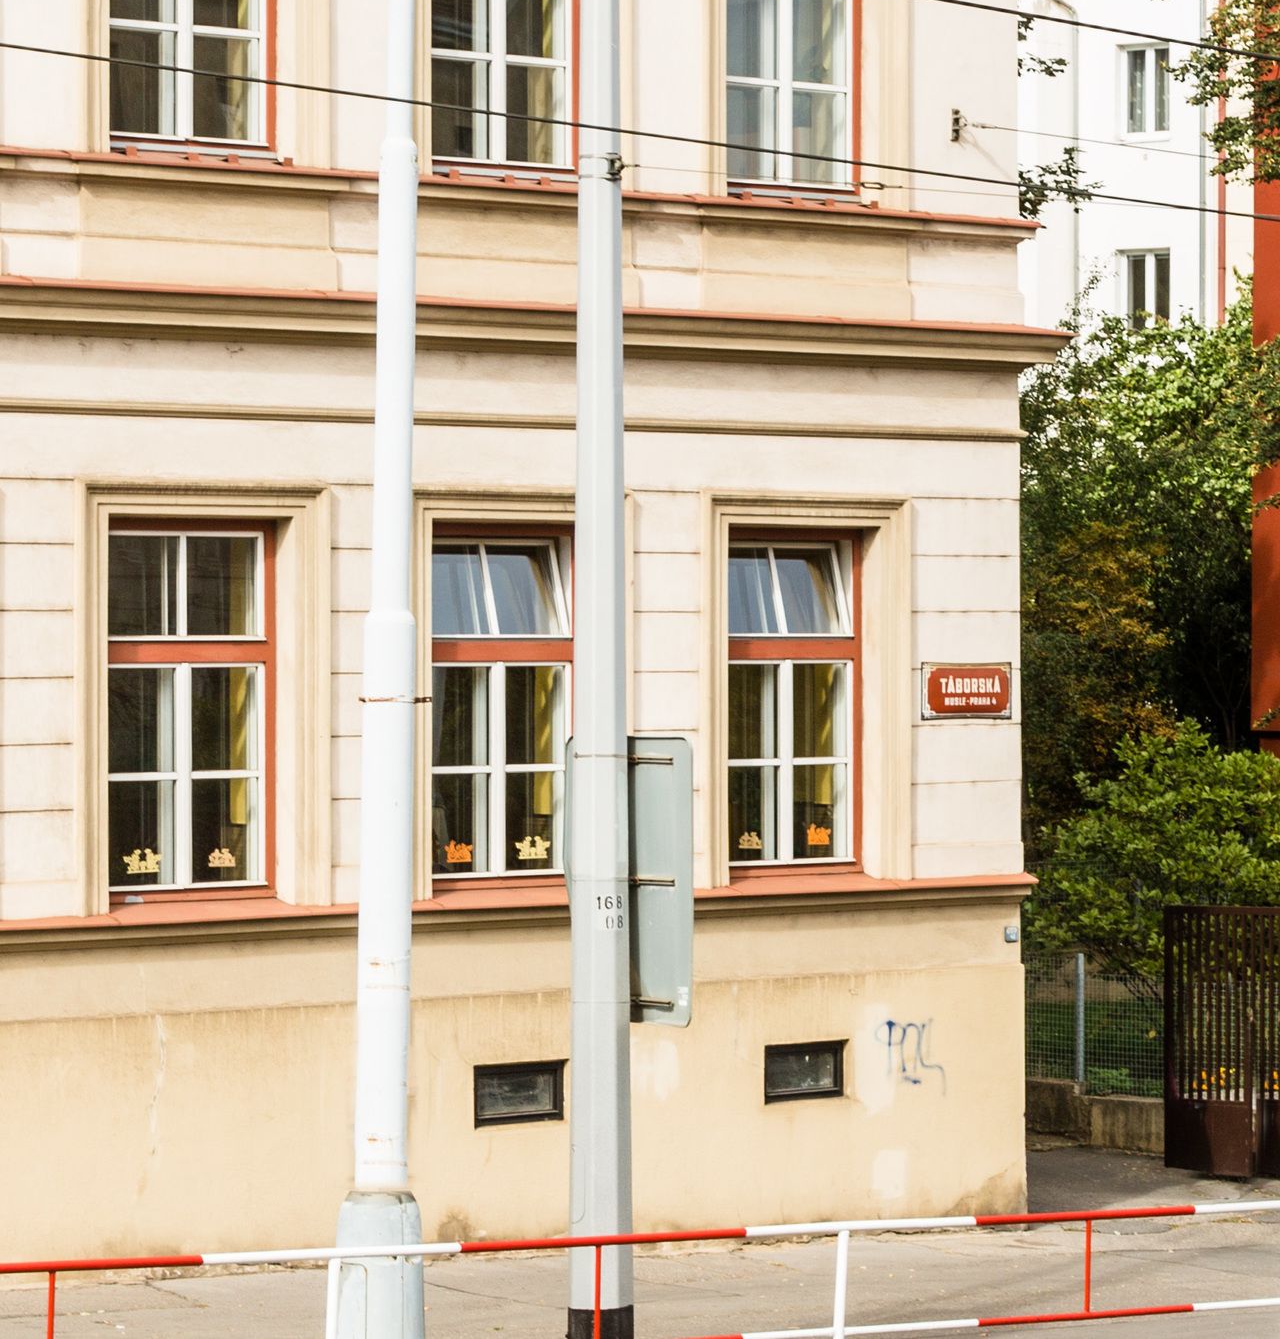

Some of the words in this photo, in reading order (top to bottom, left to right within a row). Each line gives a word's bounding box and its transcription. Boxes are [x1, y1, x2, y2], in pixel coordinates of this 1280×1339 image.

[940, 675, 1001, 693] TÁBORSKÁ
[597, 895, 622, 910] 168
[606, 915, 623, 929] 08
